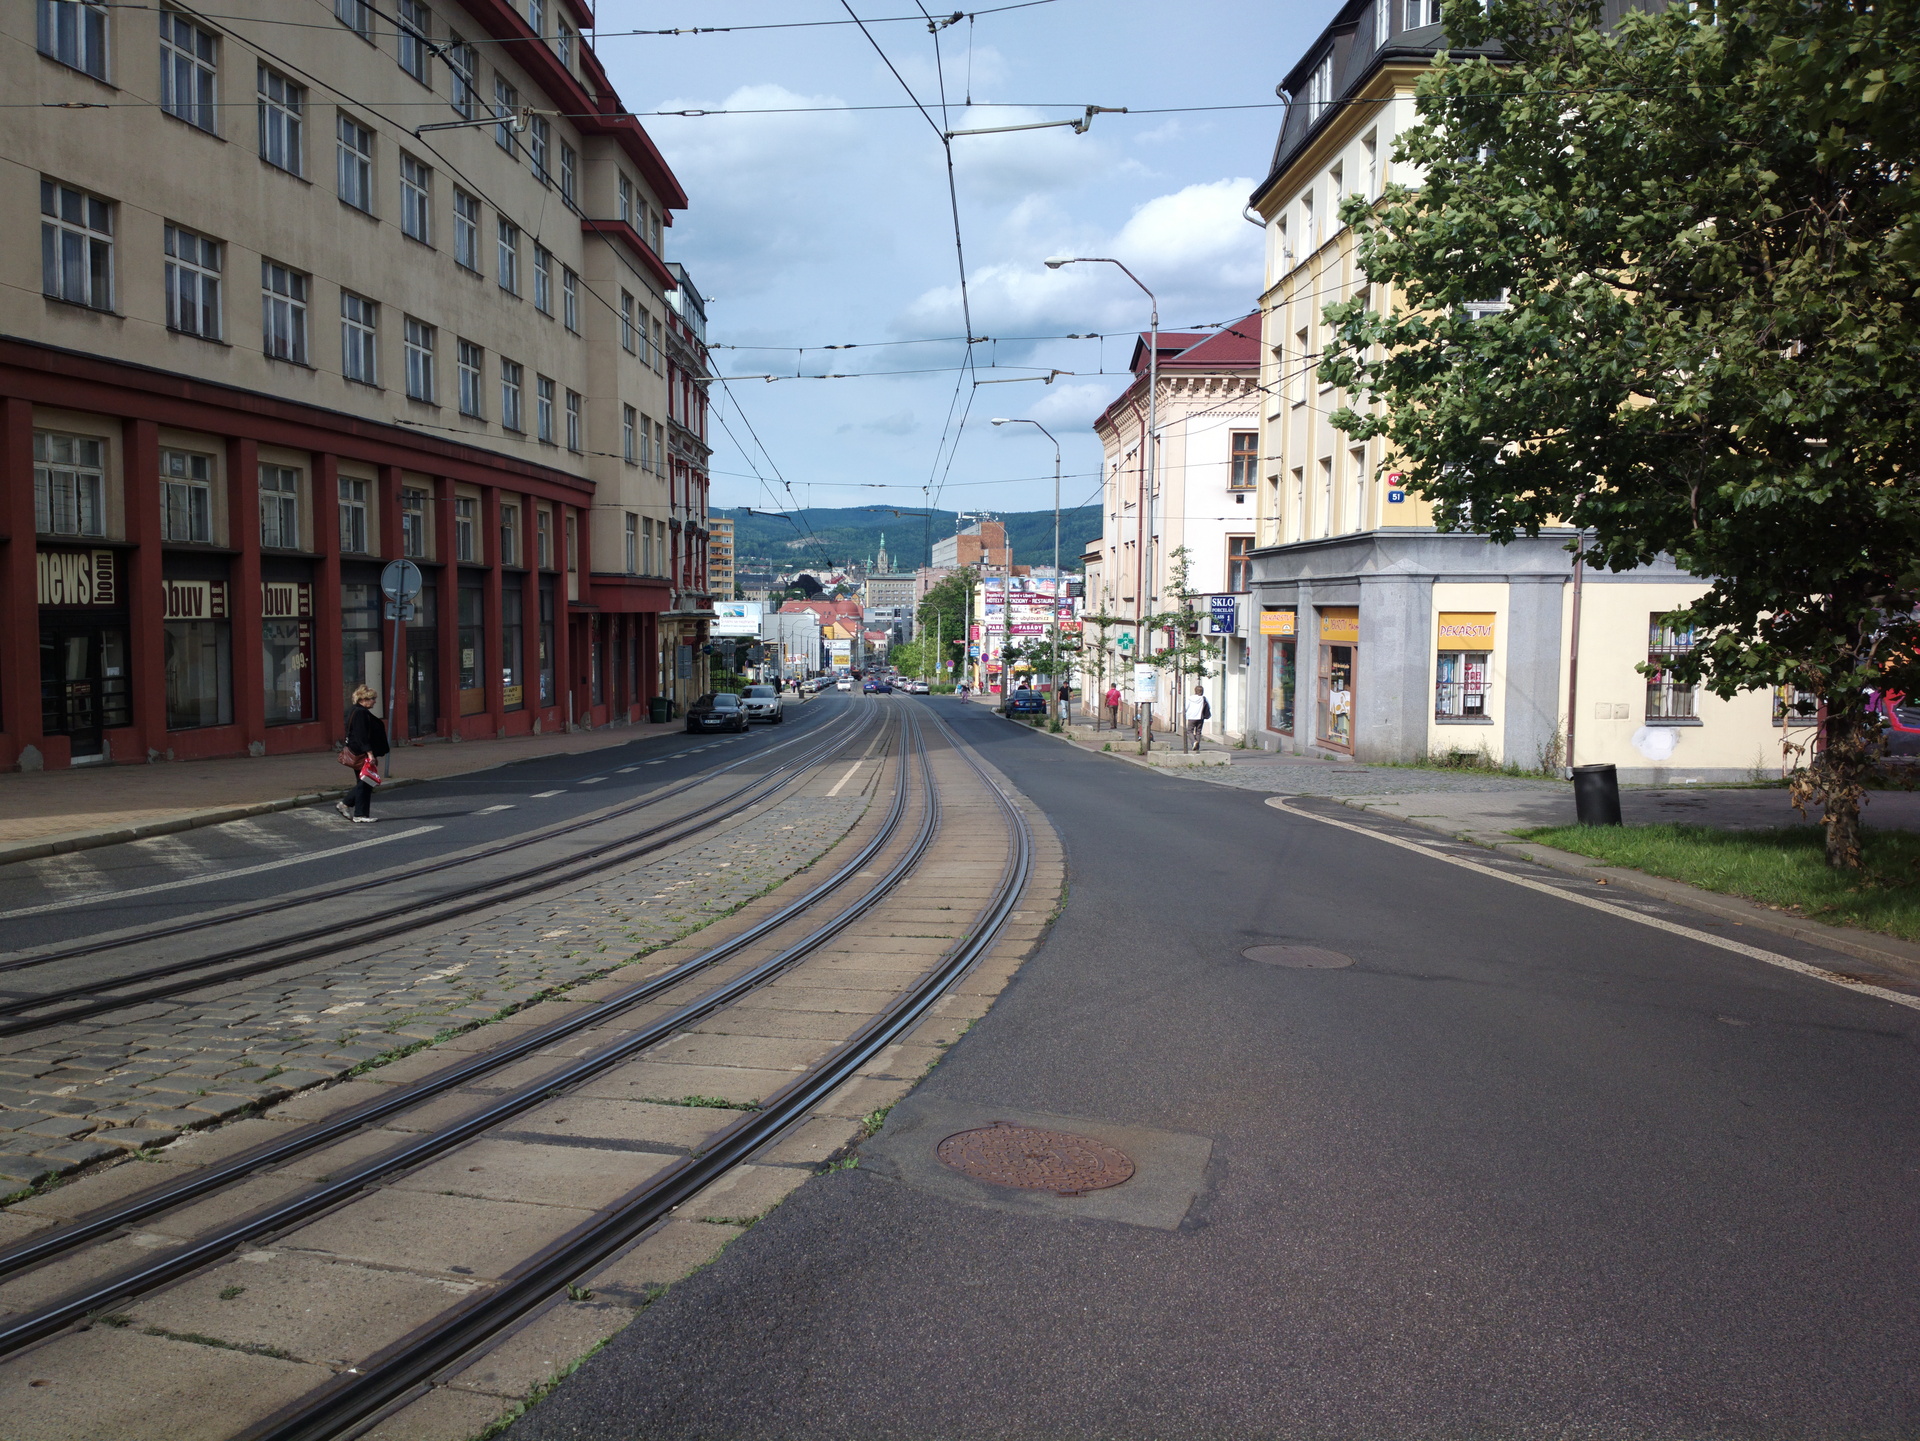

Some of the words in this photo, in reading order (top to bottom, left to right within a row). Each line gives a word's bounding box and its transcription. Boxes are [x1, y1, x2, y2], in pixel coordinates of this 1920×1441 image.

[1392, 493, 1400, 501] 51
[36, 552, 90, 605] news
[94, 554, 113, 602] boom
[261, 582, 292, 616] buv
[1212, 598, 1234, 607] SKLO
[1439, 622, 1495, 637] PEKAŘSTVÍ
